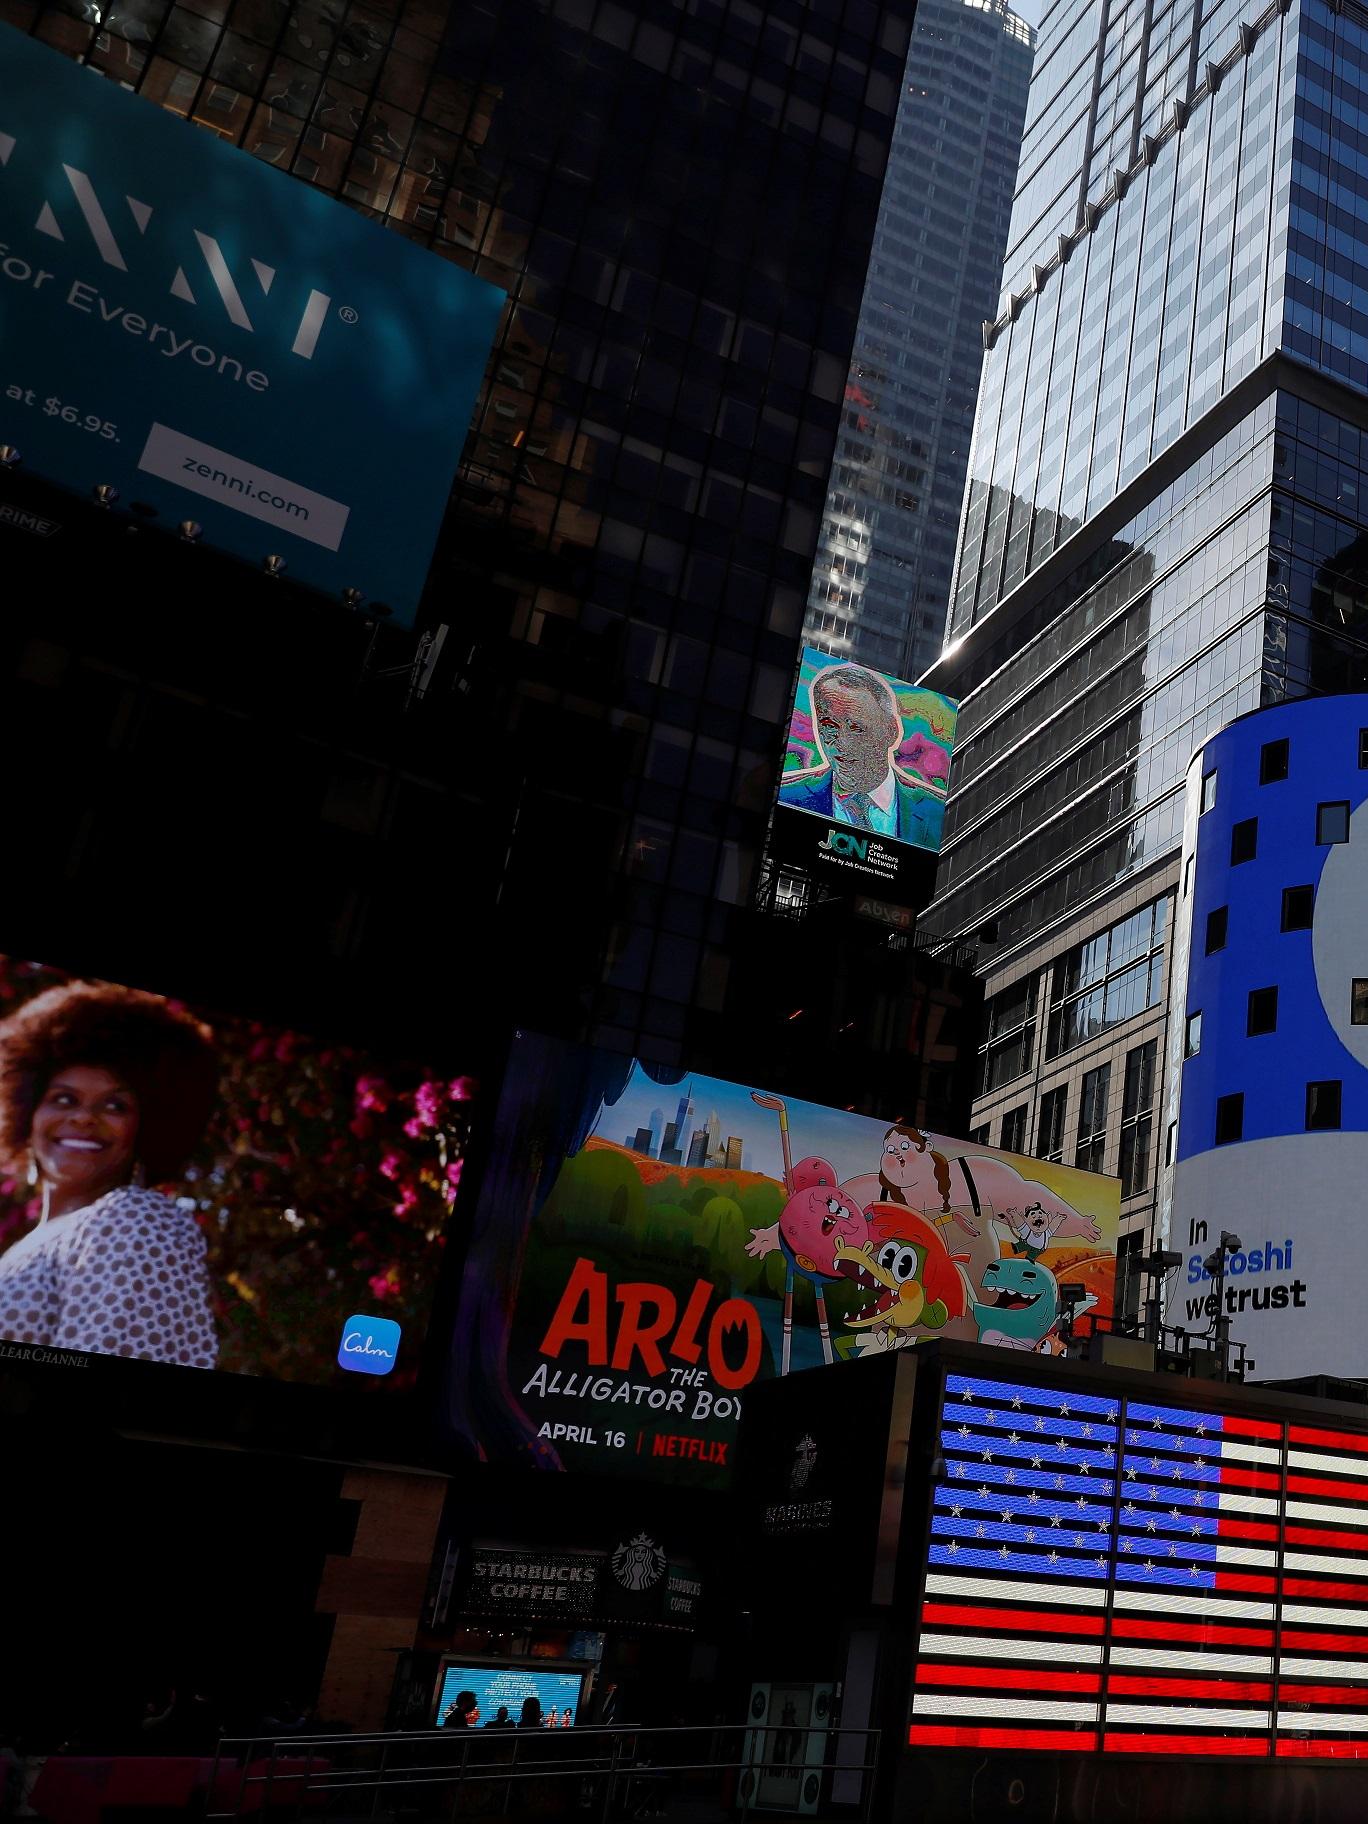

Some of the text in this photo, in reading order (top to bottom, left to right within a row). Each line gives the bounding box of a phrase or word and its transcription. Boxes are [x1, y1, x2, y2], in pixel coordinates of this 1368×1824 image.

[0, 243, 270, 392] or Everyone
[5, 383, 121, 444] at $6.95.
[182, 456, 310, 521] zenni.com
[0, 504, 52, 535] RIME
[868, 848, 899, 864] Creators
[869, 842, 884, 852] Job
[867, 856, 898, 871] Network
[1189, 1217, 1208, 1247] In
[1187, 1239, 1294, 1285] Stoshi
[1185, 1279, 1307, 1321] we trust
[538, 1256, 763, 1390] ARLO
[0, 1344, 90, 1369] LEARCHANNEL
[343, 1332, 393, 1359] Calm
[521, 1363, 687, 1413] ALLIGATOR
[670, 1367, 709, 1388] THE
[537, 1421, 729, 1467] APRIL 16 NETFLIX
[473, 1561, 597, 1583] STARBUCKS
[489, 1583, 569, 1601] COFFEE
